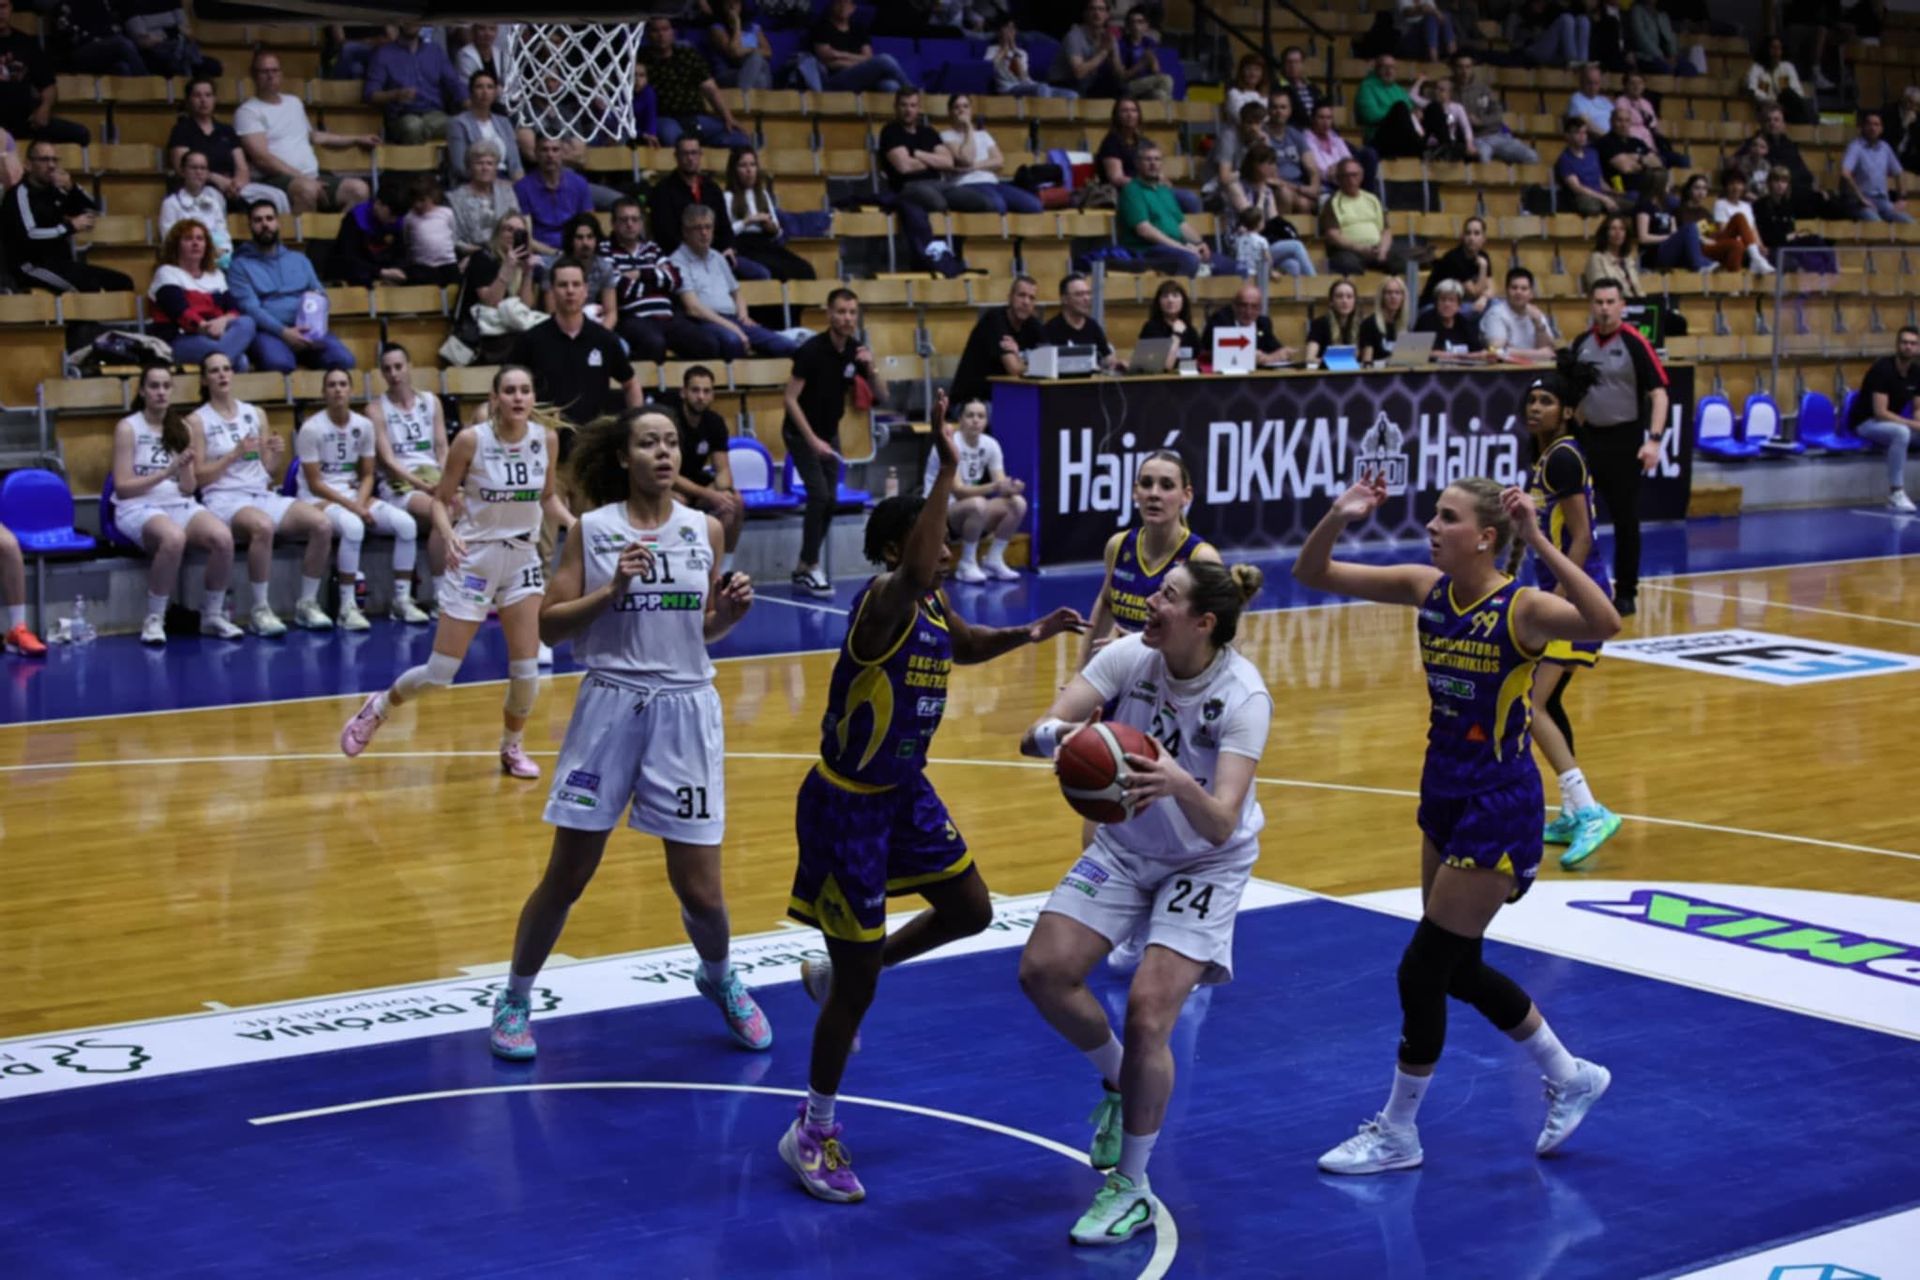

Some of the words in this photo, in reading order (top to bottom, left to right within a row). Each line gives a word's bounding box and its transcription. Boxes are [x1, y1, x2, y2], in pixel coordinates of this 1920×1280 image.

[406, 423, 421, 440] 13
[151, 446, 169, 464] 23
[337, 443, 346, 460] 5
[1207, 417, 1348, 504] DKKA!
[504, 462, 528, 486] 18
[1469, 611, 1500, 638] 99
[1153, 715, 1182, 758] 24
[676, 786, 710, 819] 31
[1167, 880, 1214, 919] 24
[235, 1003, 467, 1042] DEPÓNIA
